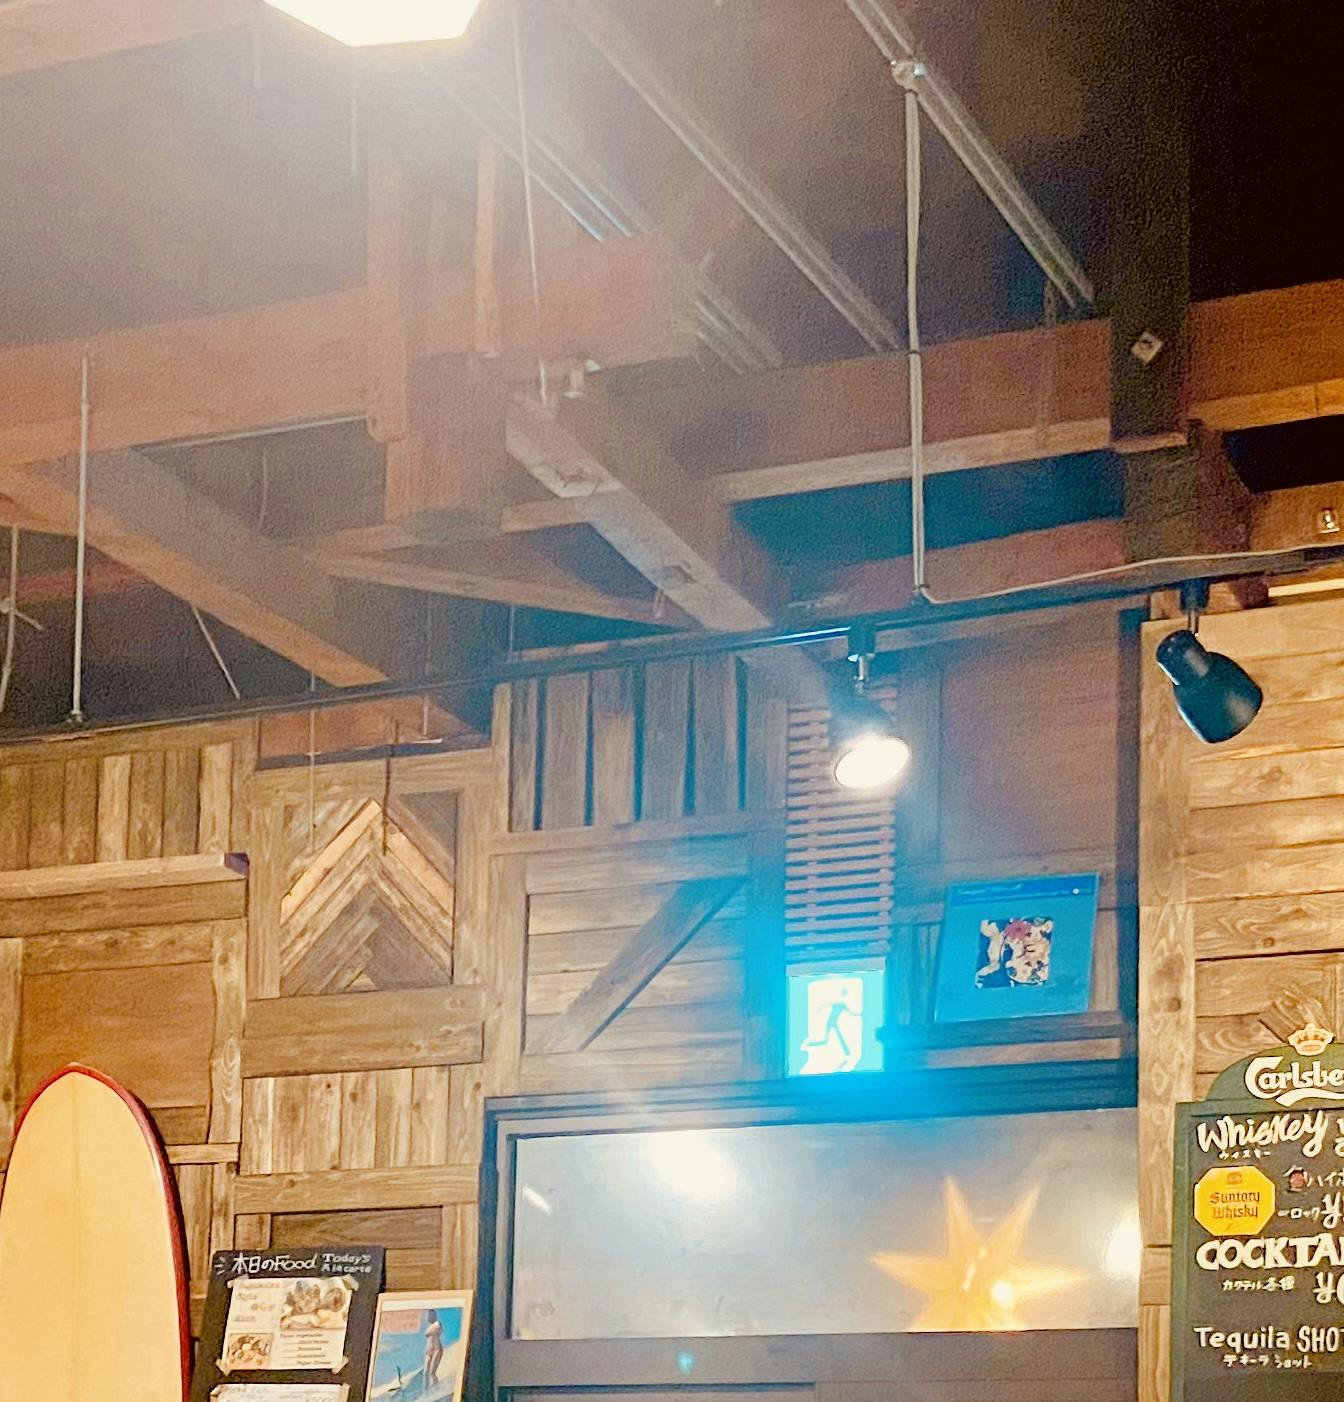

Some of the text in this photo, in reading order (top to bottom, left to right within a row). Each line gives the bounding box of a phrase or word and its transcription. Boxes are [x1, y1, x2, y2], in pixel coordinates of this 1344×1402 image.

[1197, 1110, 1328, 1158] Whiskey
[1209, 1191, 1260, 1206] Suntory
[1212, 1204, 1258, 1220] Whisky
[1194, 1325, 1290, 1354] Tequila
